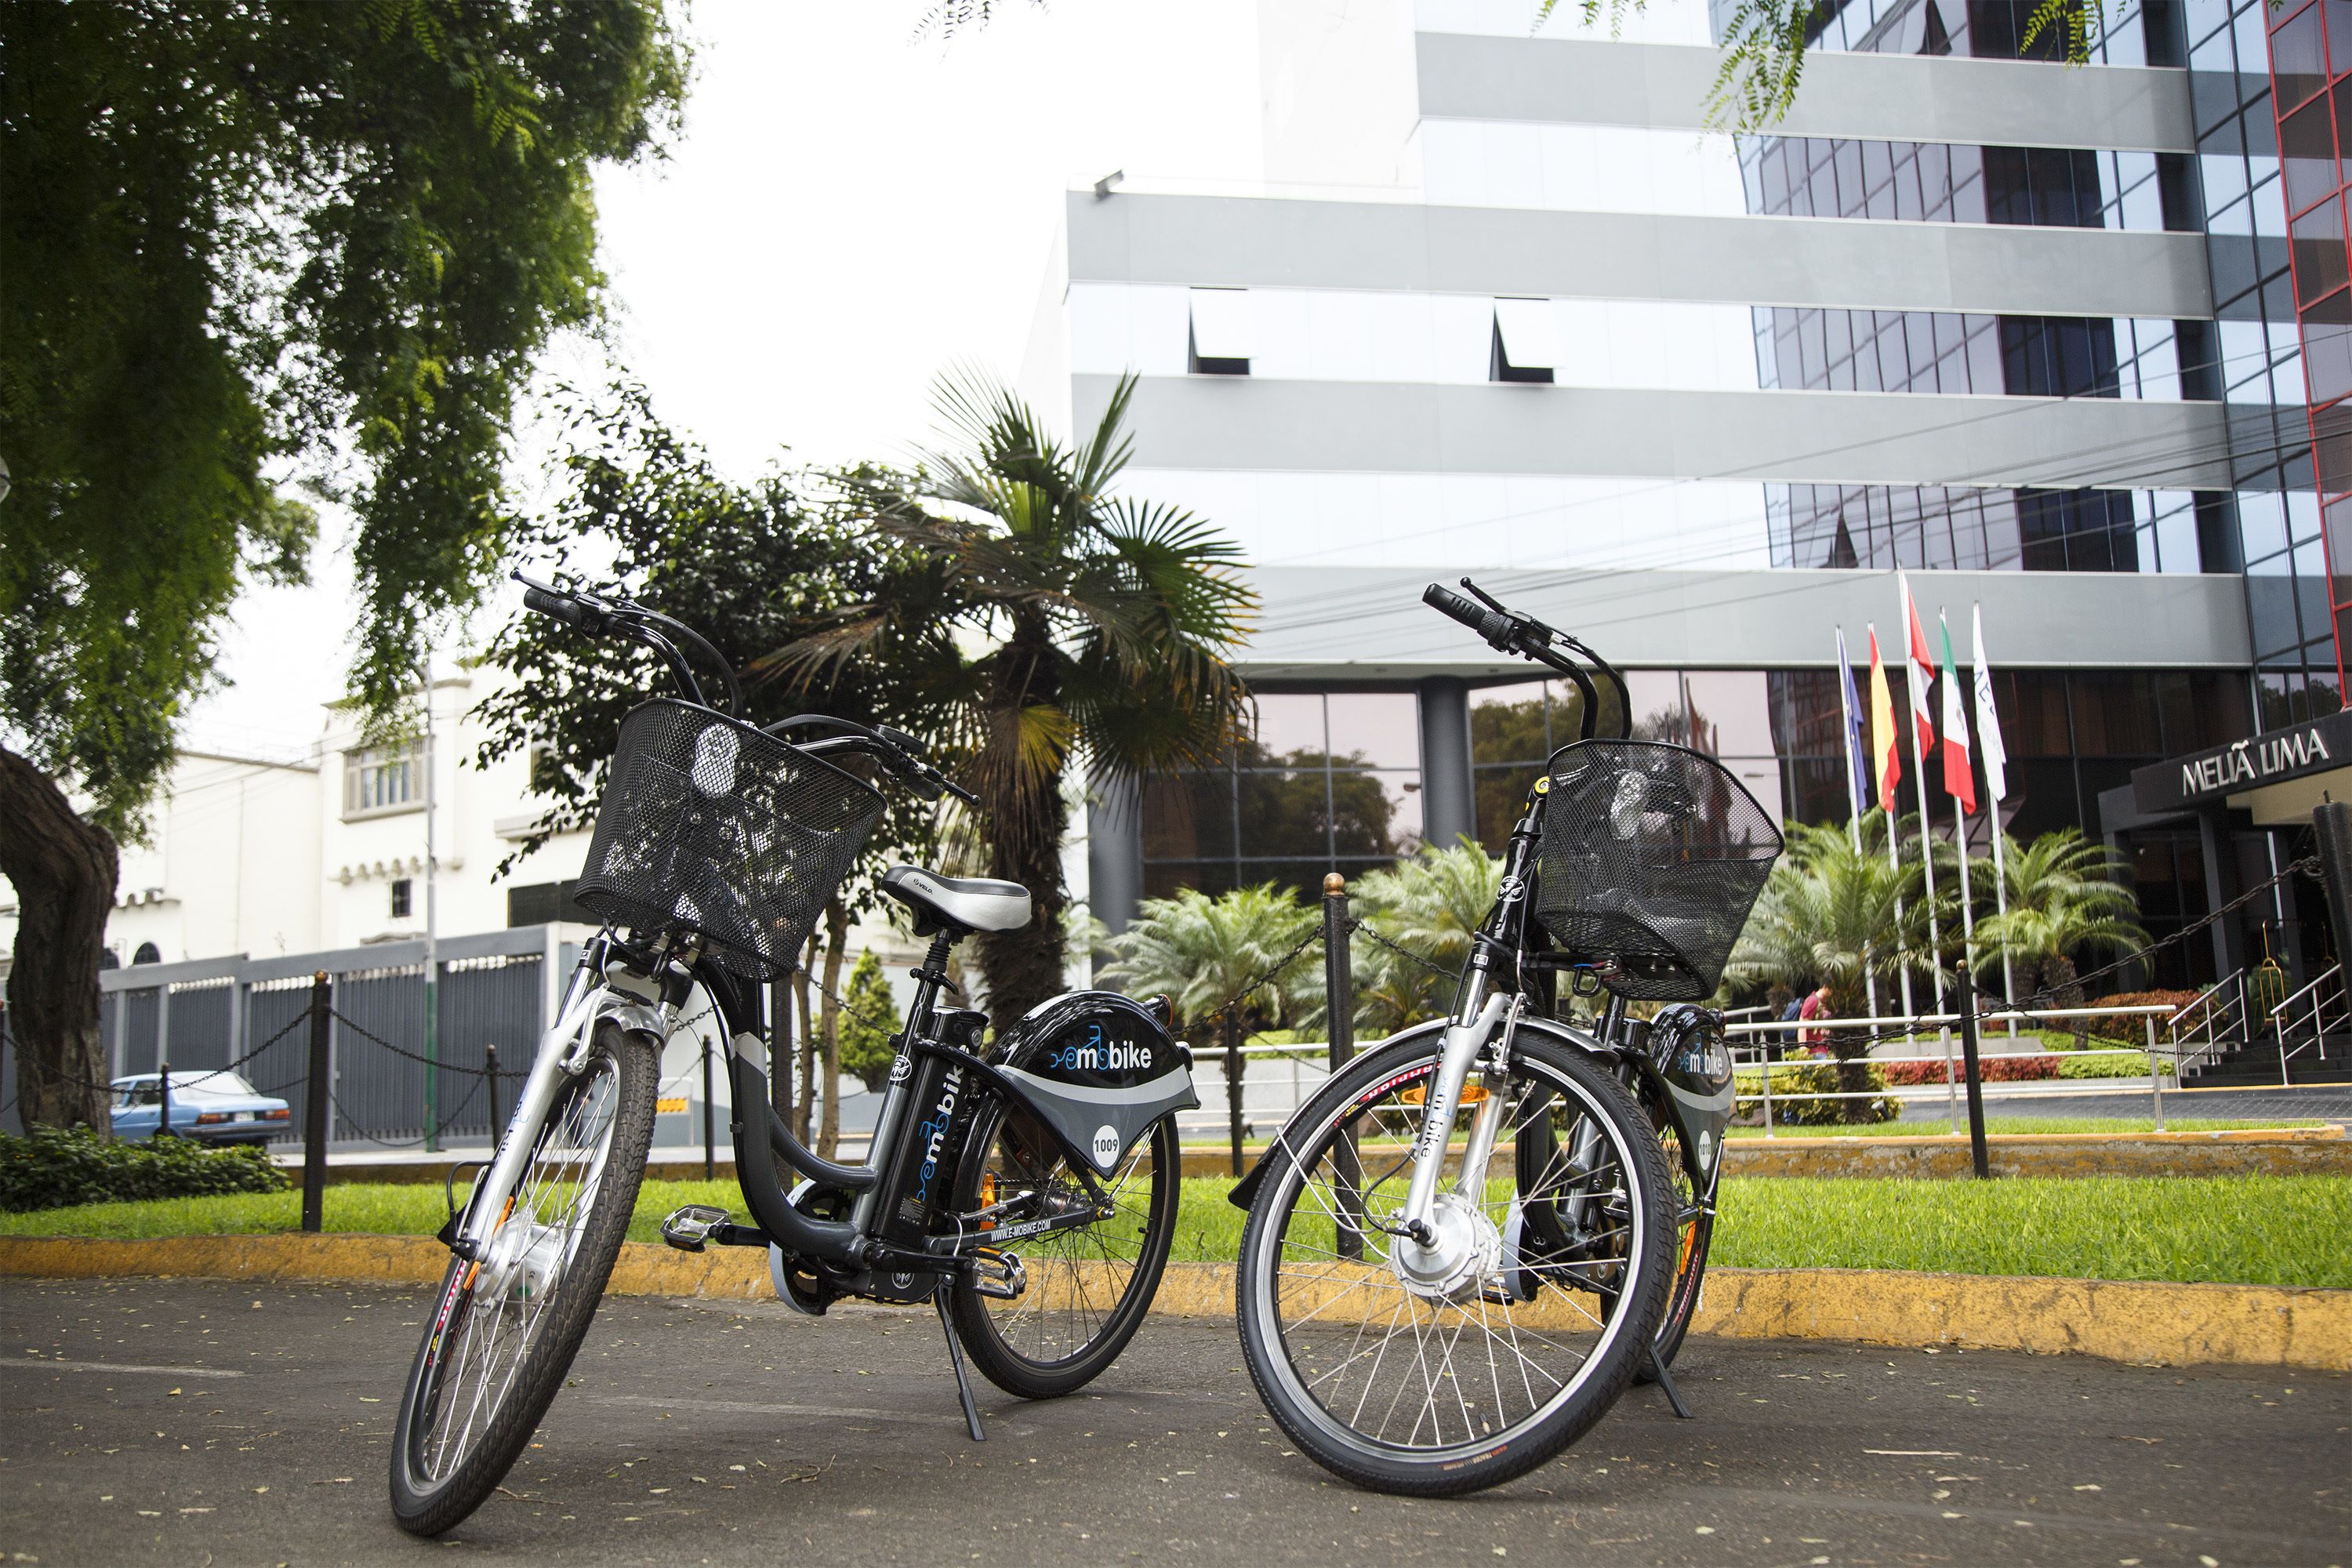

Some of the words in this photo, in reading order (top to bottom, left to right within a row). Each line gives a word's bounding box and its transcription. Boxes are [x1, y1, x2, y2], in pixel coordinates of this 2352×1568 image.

[2259, 728, 2329, 775] LIMA
[919, 883, 933, 894] VELO
[1367, 1062, 1442, 1100] AMPION
[1094, 1138, 1119, 1152] 1009
[990, 1220, 1051, 1242] WWW.E-MOBIKE.COM
